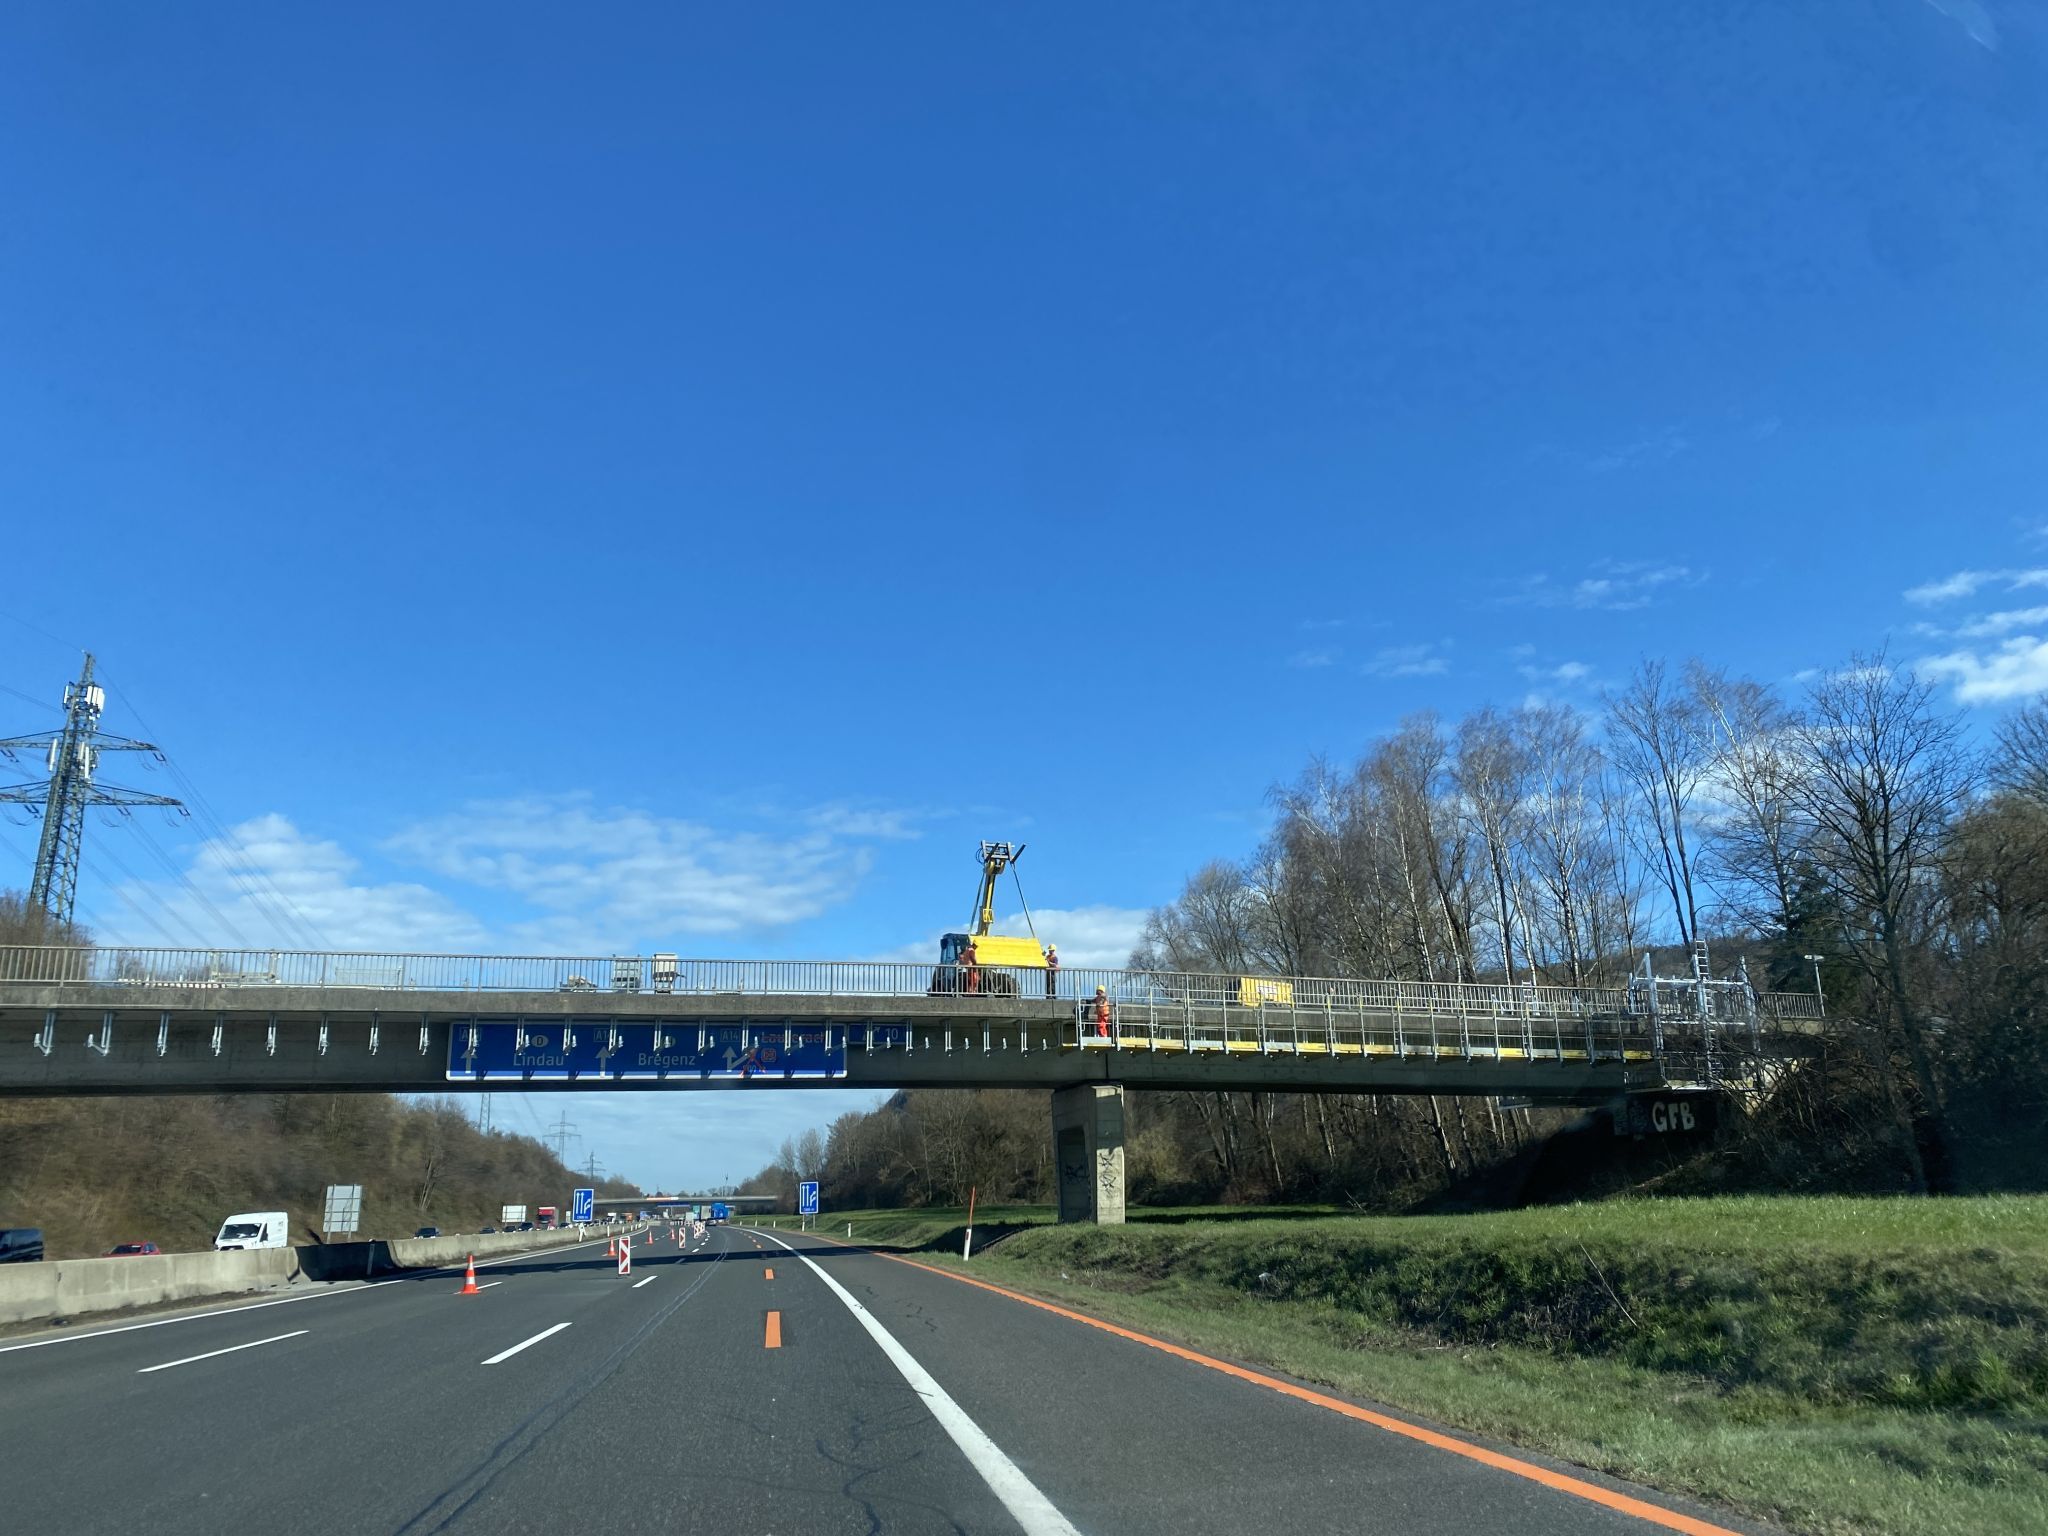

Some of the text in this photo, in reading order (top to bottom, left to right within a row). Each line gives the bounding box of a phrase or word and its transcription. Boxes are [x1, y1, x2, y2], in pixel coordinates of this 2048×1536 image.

[595, 1030, 609, 1041] A1
[722, 1030, 739, 1041] A14
[884, 1028, 899, 1041] 10
[513, 1052, 564, 1066] Lindau
[638, 1052, 696, 1069] Bregenz
